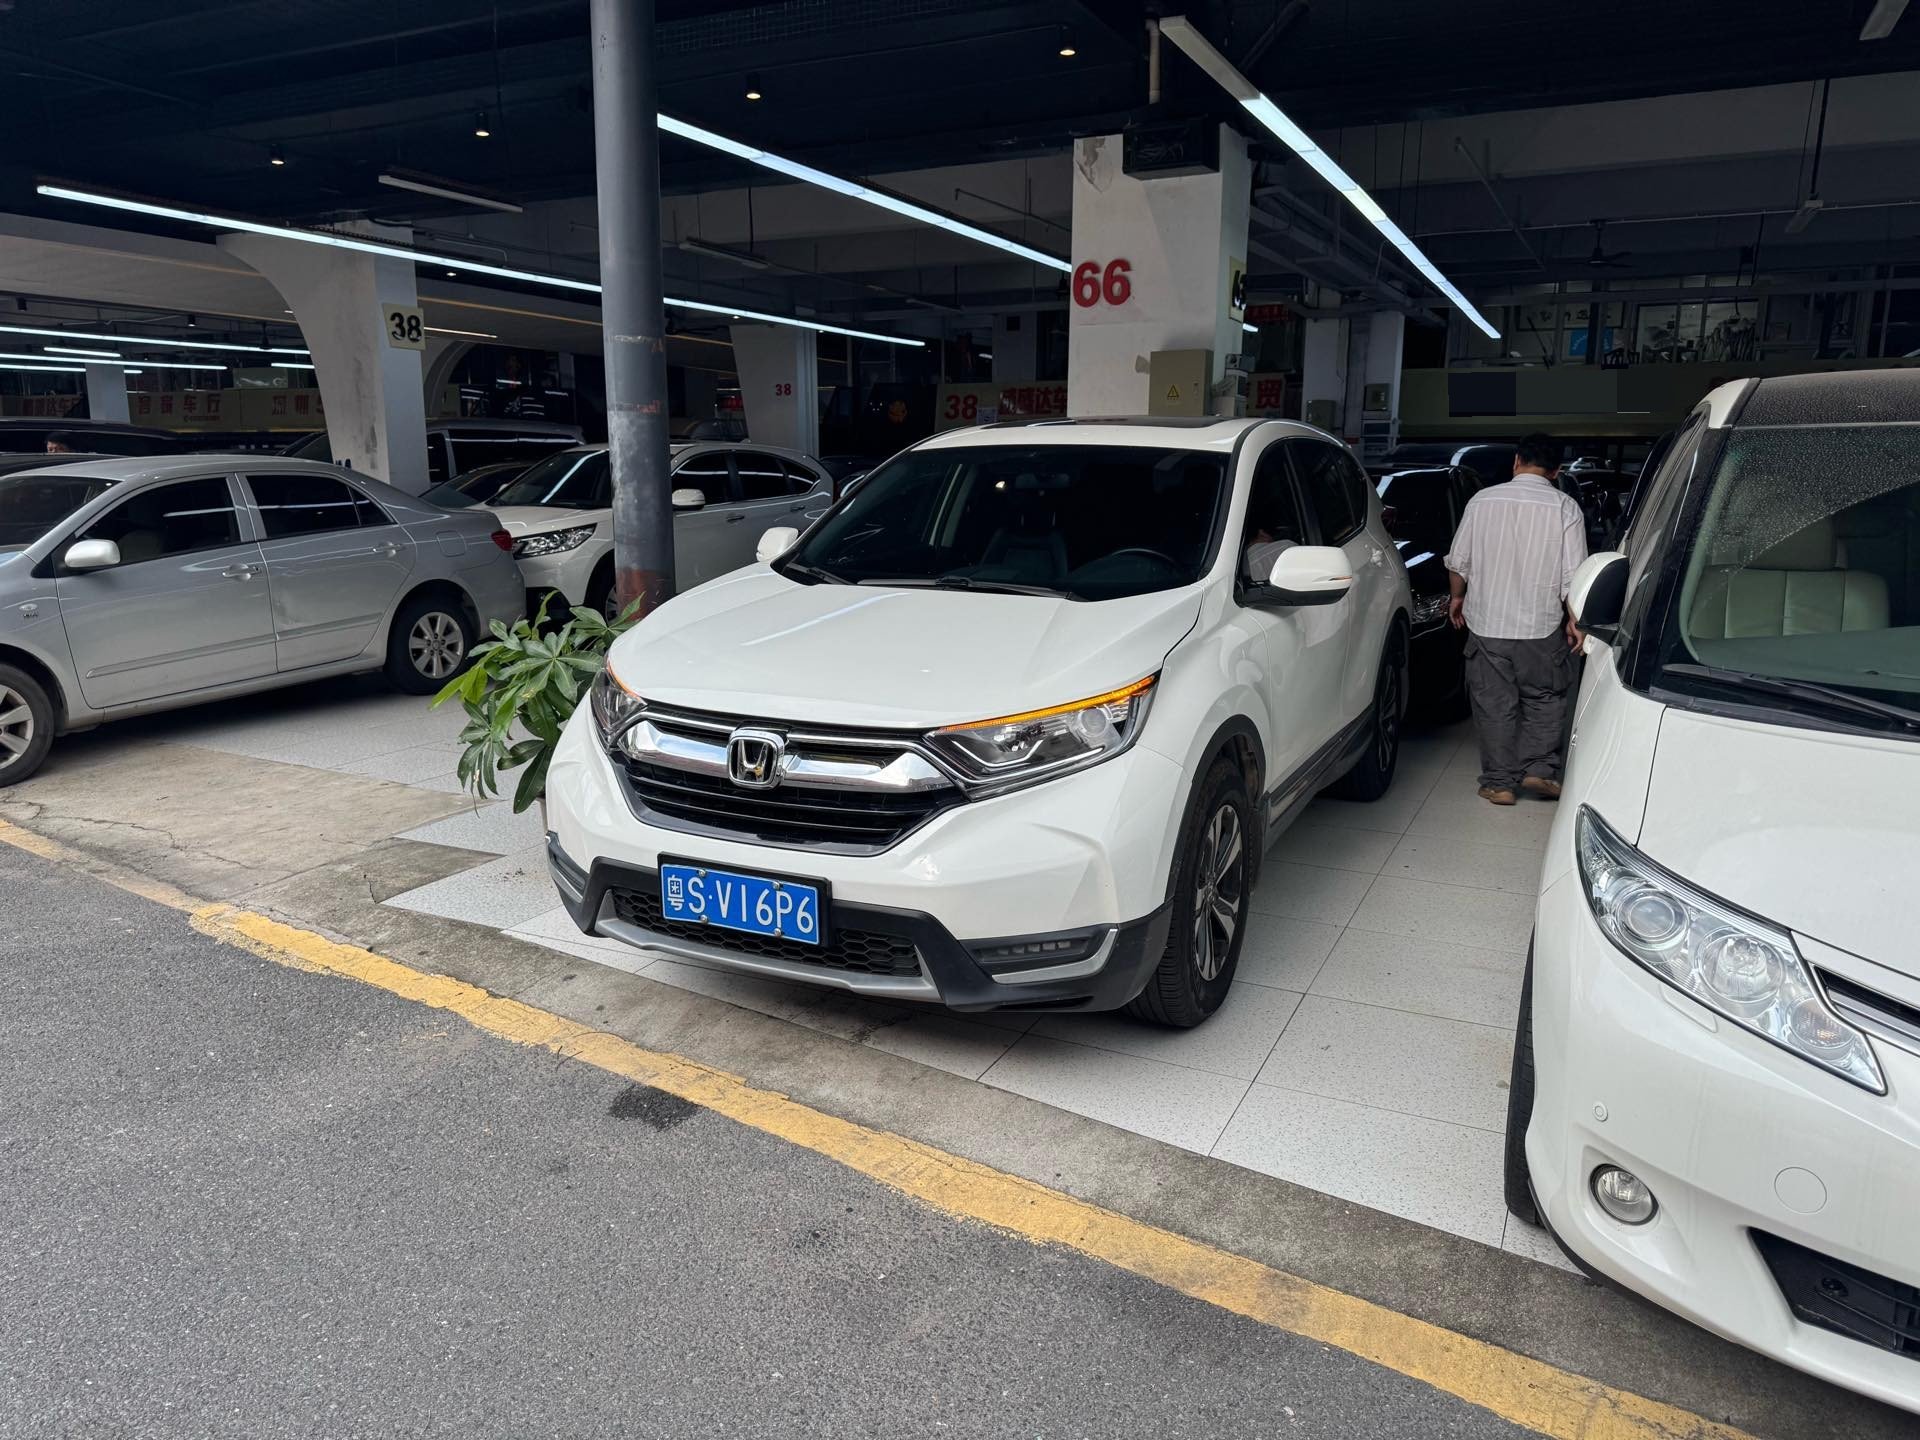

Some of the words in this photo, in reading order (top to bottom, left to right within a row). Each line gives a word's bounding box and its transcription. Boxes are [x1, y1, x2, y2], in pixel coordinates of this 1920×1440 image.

[1073, 259, 1131, 308] 66
[389, 312, 422, 342] 38
[775, 383, 792, 396] 38
[945, 394, 978, 419] 38
